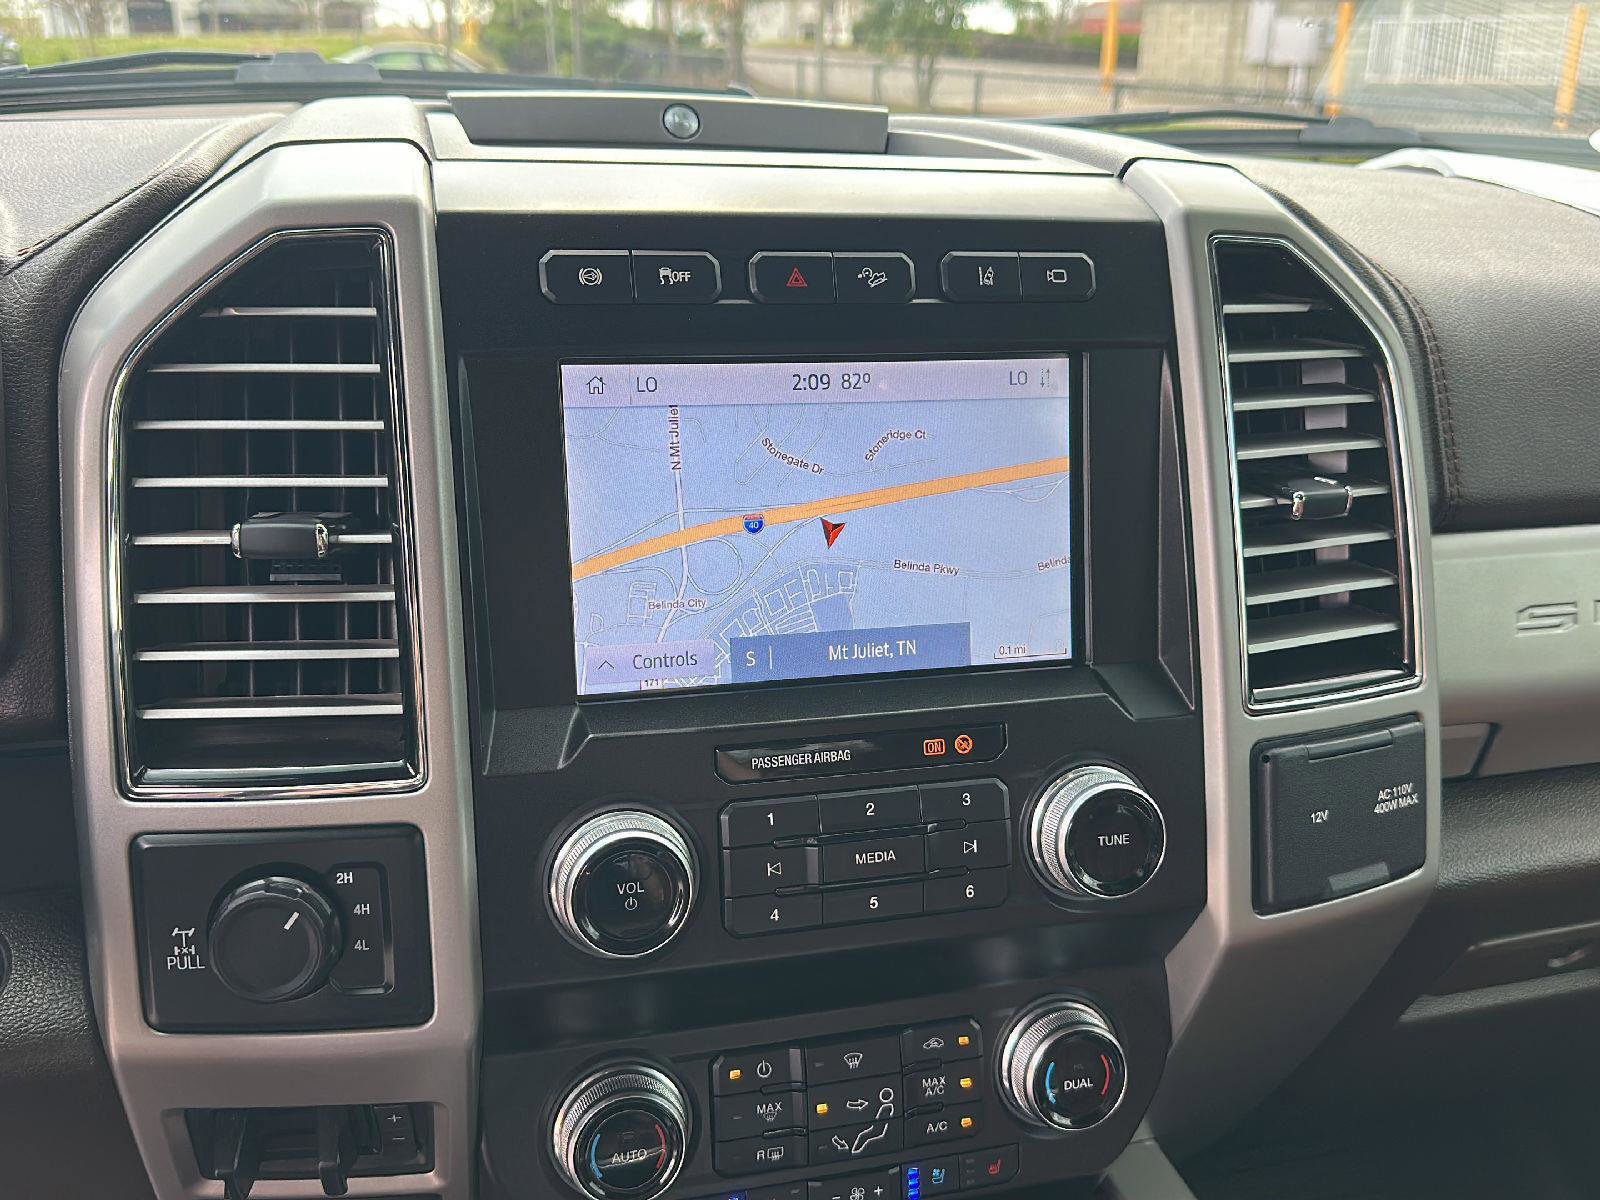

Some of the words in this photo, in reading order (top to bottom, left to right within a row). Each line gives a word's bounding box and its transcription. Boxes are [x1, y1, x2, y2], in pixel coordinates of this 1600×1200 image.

[672, 271, 691, 282] OFF
[636, 376, 658, 393] LO
[792, 373, 831, 391] 2:09
[1009, 370, 1028, 386] LO
[669, 441, 681, 457] Mt
[865, 429, 912, 462] Stoneridge
[914, 430, 927, 440] Ct
[761, 437, 810, 471] Stonegate
[811, 463, 825, 475] Dr
[670, 461, 682, 470] N
[748, 521, 759, 529] 40
[894, 559, 931, 574] Belinda
[933, 562, 960, 577] Pkwy
[648, 600, 685, 610] Belinda
[687, 598, 707, 610] City
[828, 645, 849, 661] Mt
[851, 642, 894, 660] Juliet,
[896, 639, 917, 656] TN
[999, 645, 1011, 655] 0.1
[1012, 645, 1026, 654] mi
[633, 650, 698, 670] Controls
[745, 651, 756, 667] S
[927, 742, 943, 754] ON
[751, 753, 812, 770] PASSENGER
[813, 750, 851, 765] AIRBAG
[1378, 788, 1392, 801] AC
[1392, 782, 1413, 797] 110V
[962, 793, 971, 806] 3
[1373, 799, 1398, 814] 400W
[1398, 793, 1418, 808] MAX
[865, 803, 875, 816] 2
[1310, 810, 1329, 823] 12V
[767, 812, 775, 826] 1
[1098, 833, 1131, 847] TUNE
[855, 850, 896, 865] MEDIA
[336, 871, 353, 884] 2H
[617, 881, 645, 895] VOL
[965, 885, 975, 898] 6
[353, 903, 370, 915] 4H
[869, 896, 879, 909] 5
[770, 908, 780, 921] 4
[354, 939, 370, 951] 4L
[167, 956, 206, 970] PULL
[922, 1076, 946, 1088] MAX
[1064, 1077, 1094, 1091] DUAL
[925, 1085, 945, 1097] A/C
[756, 1101, 783, 1115] MAX
[926, 1121, 948, 1134] A/C
[611, 1148, 648, 1164] AUTO
[756, 1150, 765, 1161] R
